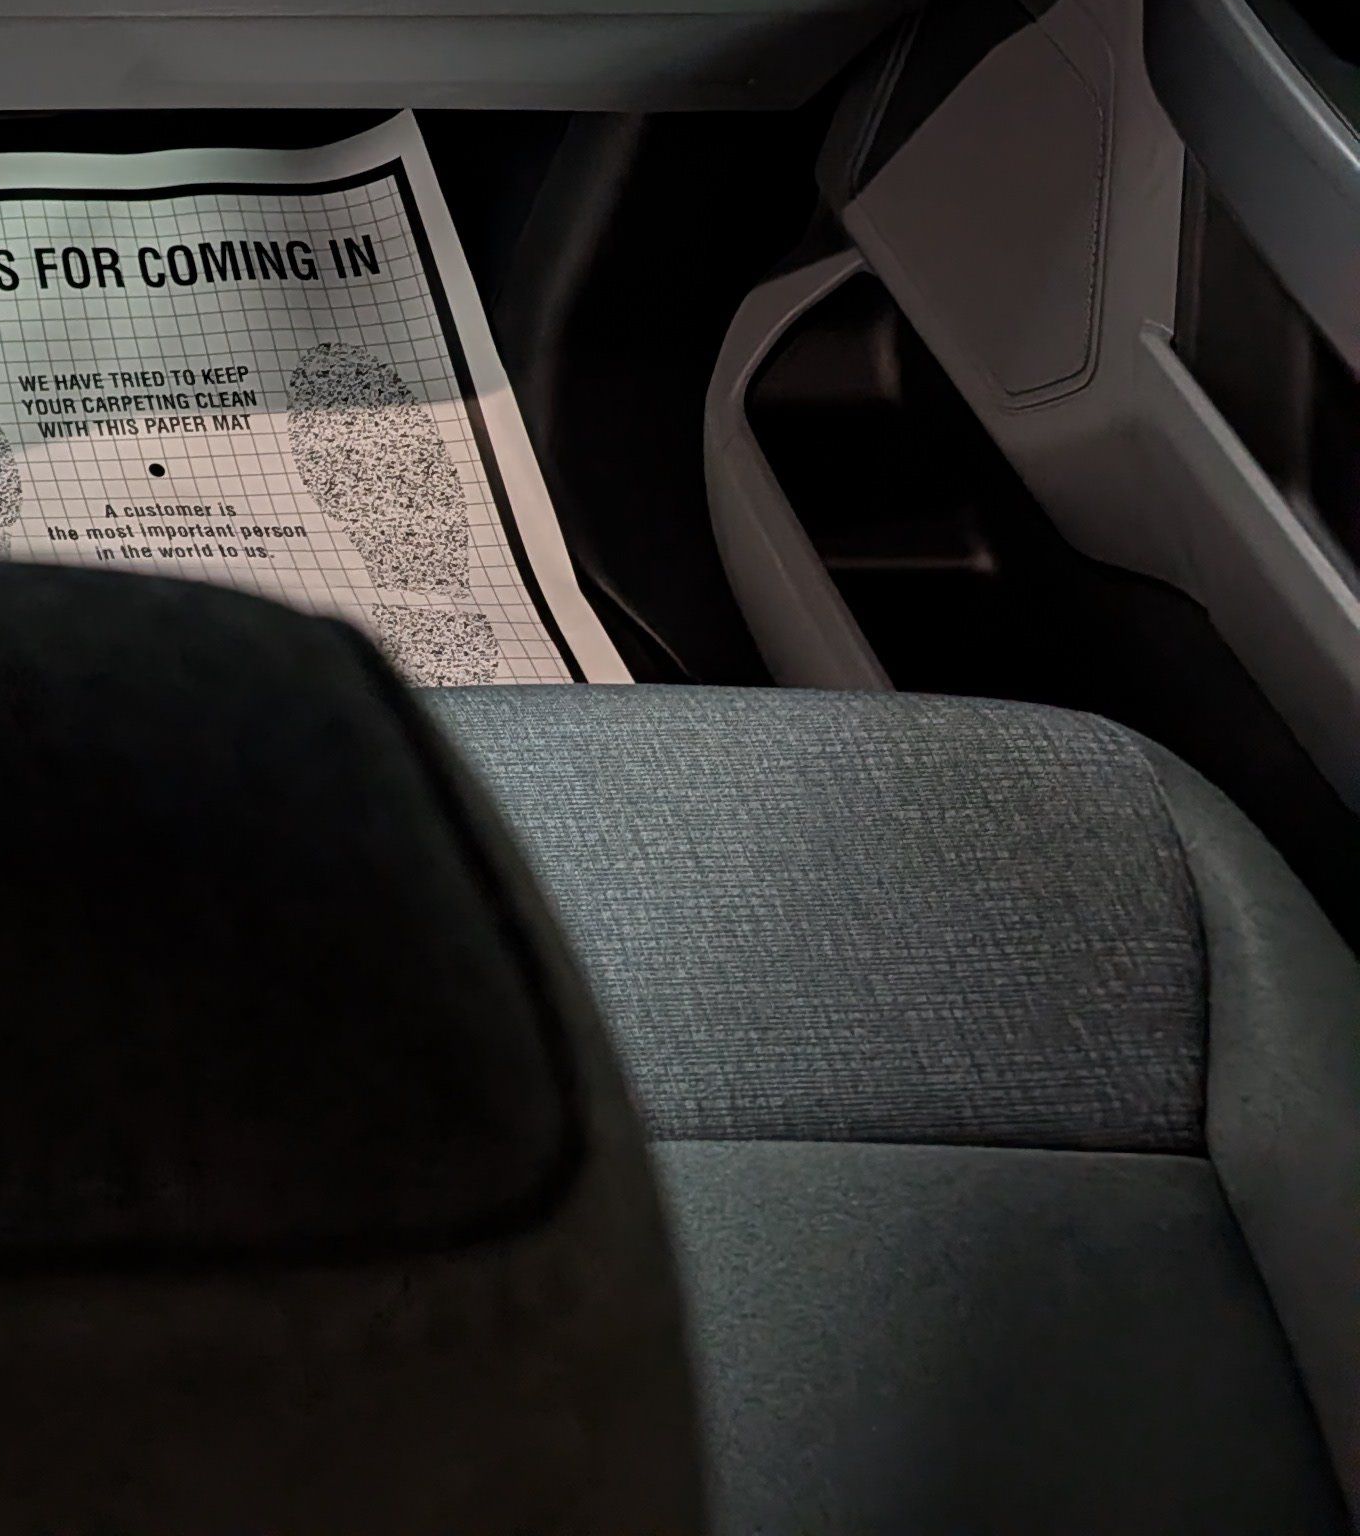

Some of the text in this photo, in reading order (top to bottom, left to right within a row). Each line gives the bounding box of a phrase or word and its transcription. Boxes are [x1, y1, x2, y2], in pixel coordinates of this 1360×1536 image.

[33, 246, 125, 291] FOR
[137, 240, 319, 289] COMING
[328, 234, 381, 279] IN
[19, 366, 249, 392] WE HAVE TRIED TO KEEP
[22, 390, 257, 415] YOUR CARPETING CLEAN
[38, 415, 251, 438] WITH THIS PAPER MAT
[105, 502, 237, 518] A customer is
[48, 523, 307, 541] the most important person
[96, 544, 275, 560] in the world to us.
